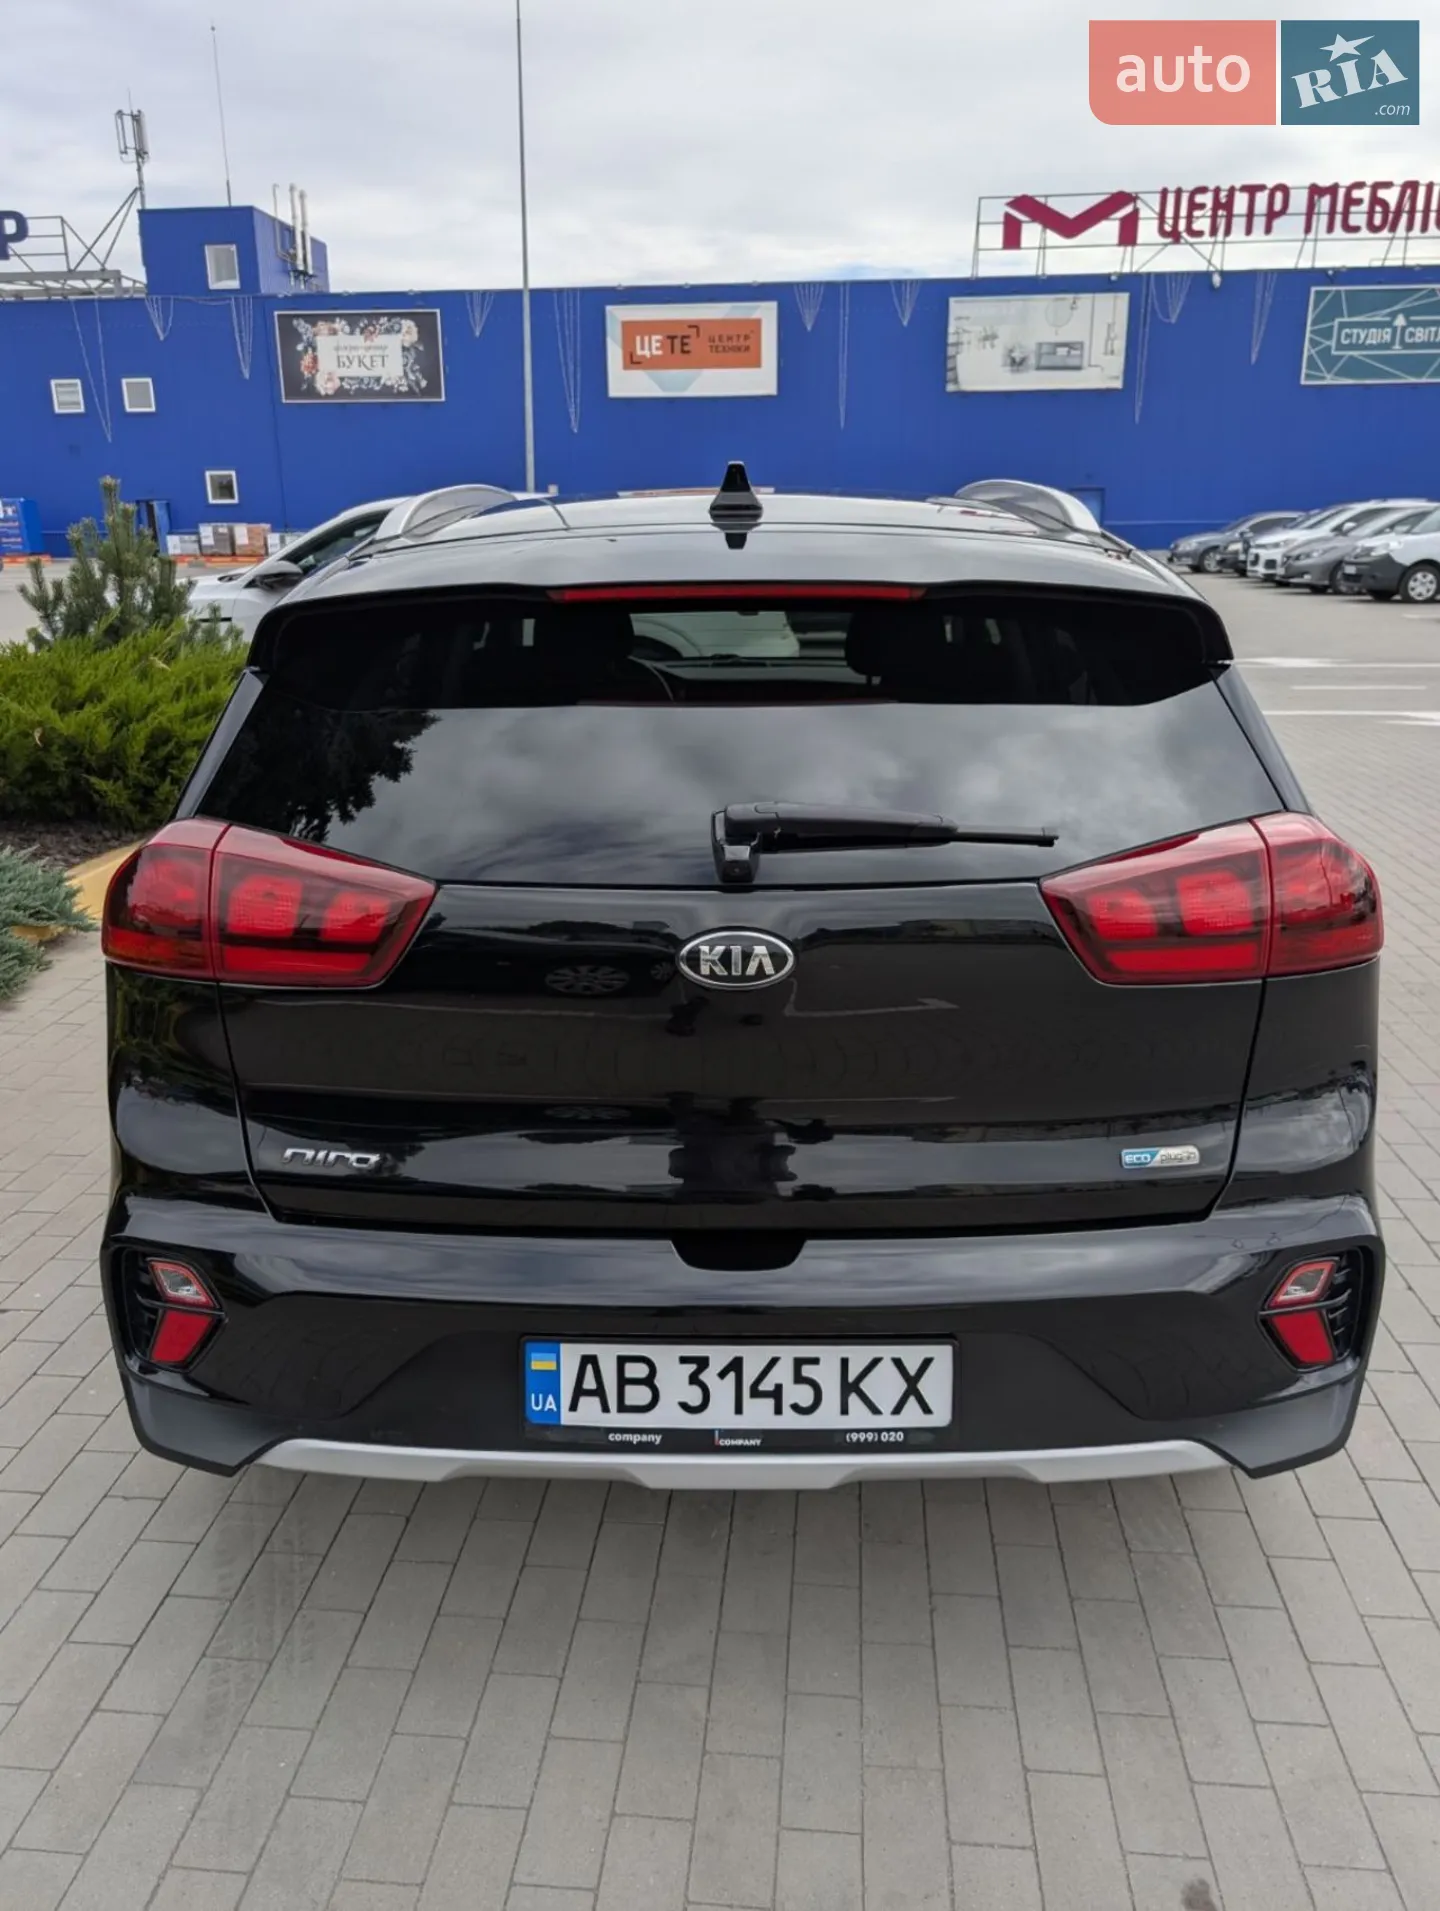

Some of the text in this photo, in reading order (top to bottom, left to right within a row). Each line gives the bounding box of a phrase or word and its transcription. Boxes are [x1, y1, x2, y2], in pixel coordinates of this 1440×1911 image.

[1158, 180, 1440, 244] ЦЕНТР МЕБЛІ
[708, 333, 751, 344] ЦЕНТР
[1340, 327, 1392, 346] СТУДІЯ
[336, 354, 389, 371] БУКЕТ
[698, 945, 775, 976] KIA
[568, 1354, 935, 1416] AB 3145 KX
[530, 1393, 558, 1412] UA
[608, 1432, 662, 1445] company
[846, 1431, 904, 1443] (999) 020
